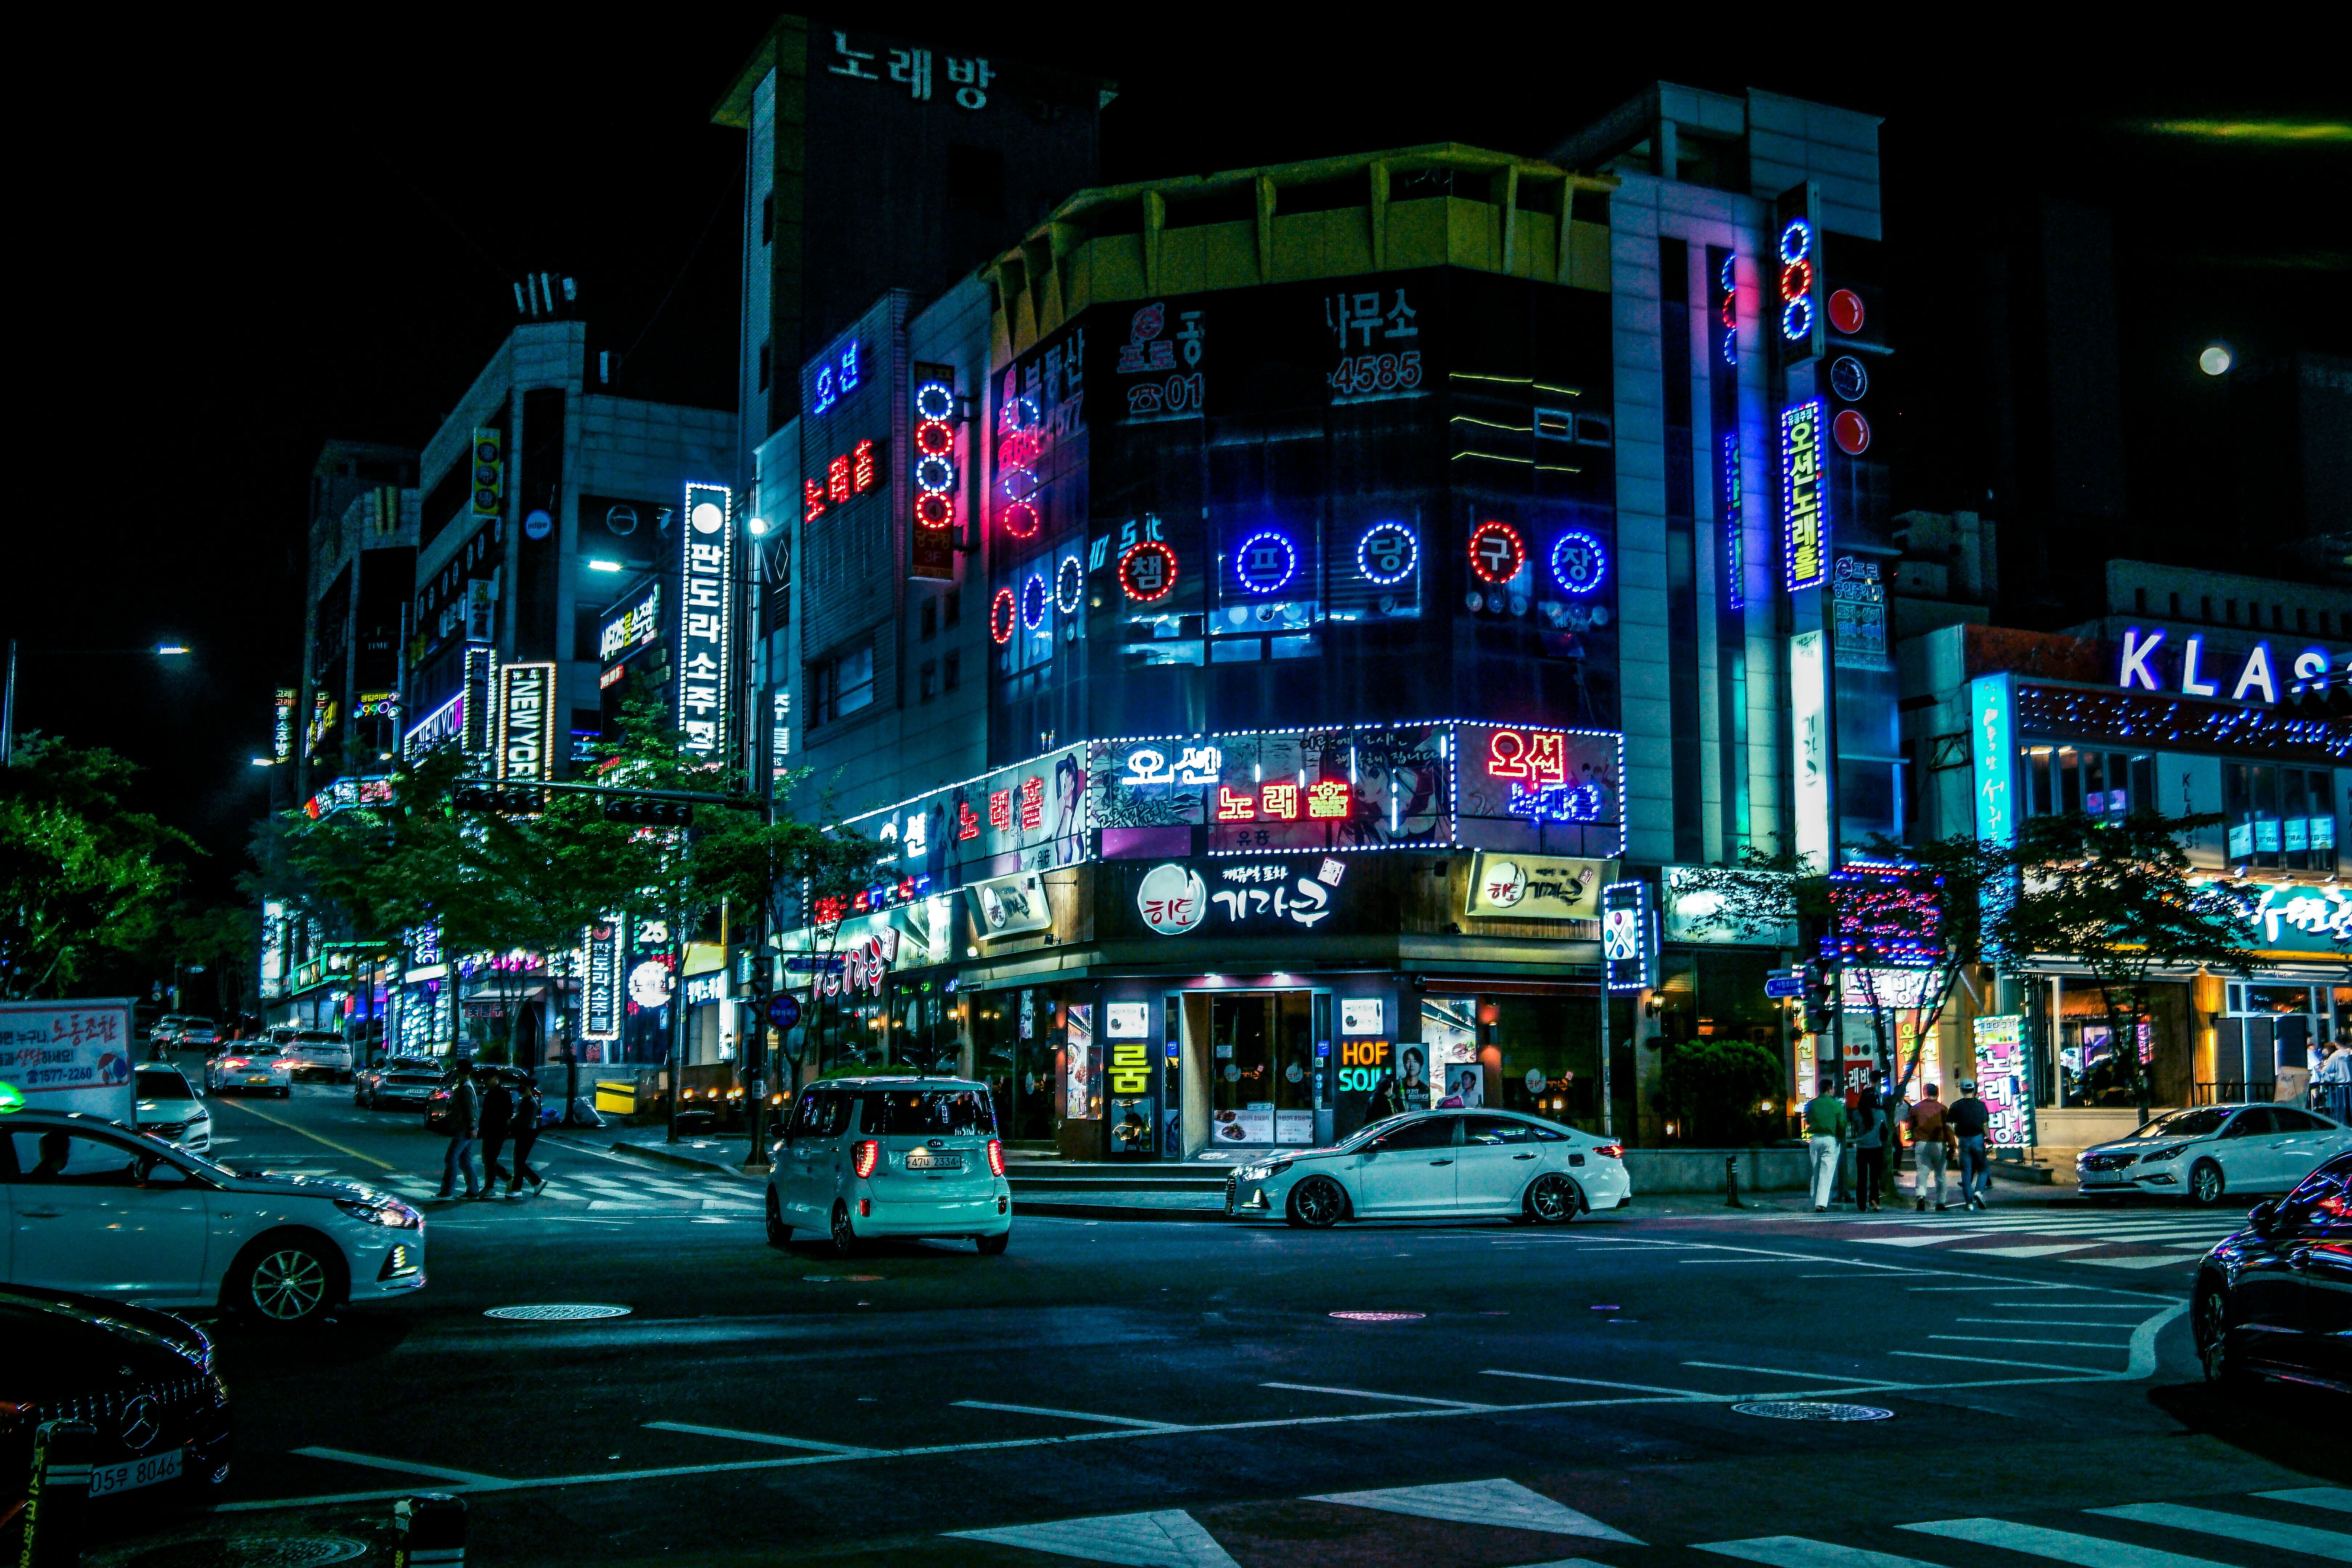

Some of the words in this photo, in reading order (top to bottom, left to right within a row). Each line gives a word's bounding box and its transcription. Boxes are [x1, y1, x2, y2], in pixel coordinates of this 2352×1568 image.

[828, 30, 996, 109] 노래방
[1333, 351, 1423, 394] 4585
[1788, 410, 1813, 427] 유흥주점
[1788, 422, 1820, 581] 오션노래홀
[1131, 555, 1162, 589] 챔
[1250, 547, 1279, 581] 프
[1370, 536, 1406, 570] 당
[1479, 538, 1511, 571] 구
[1561, 549, 1593, 582] 장
[690, 544, 723, 644] 판도라
[2119, 630, 2352, 703] KLAS
[275, 690, 292, 699] 고래
[1488, 731, 1564, 786] 오션
[959, 776, 1044, 841] 노래홀
[1218, 781, 1349, 820] 노래홀
[1037, 849, 1052, 865] 유흥
[1236, 829, 1271, 847] 유흥
[1263, 865, 1288, 882] 포차
[639, 920, 668, 943] 25
[52, 1014, 117, 1046] 노동조합
[1108, 1044, 1152, 1093] 룸
[1342, 1041, 1389, 1066] HOF
[1983, 1048, 2015, 1143] 노래방
[934, 1157, 957, 1167] 2334
[91, 1466, 128, 1493] 05무
[136, 1454, 175, 1484] 8046
